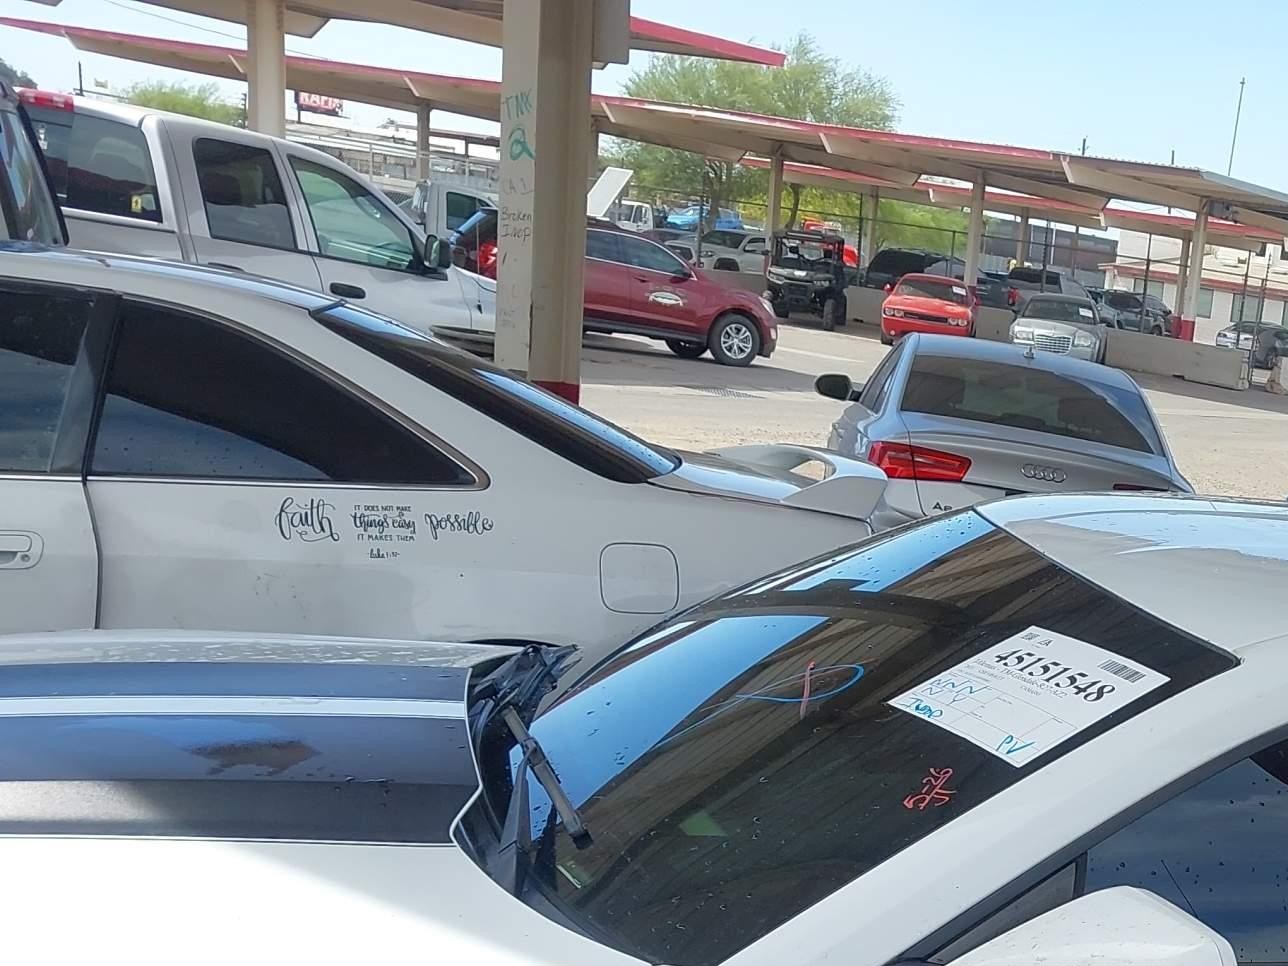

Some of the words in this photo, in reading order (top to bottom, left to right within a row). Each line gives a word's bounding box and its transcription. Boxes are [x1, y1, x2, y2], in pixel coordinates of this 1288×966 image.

[509, 126, 535, 161] 2
[275, 497, 340, 542] faith
[424, 511, 494, 540] possible
[994, 649, 1115, 702] 45151548
